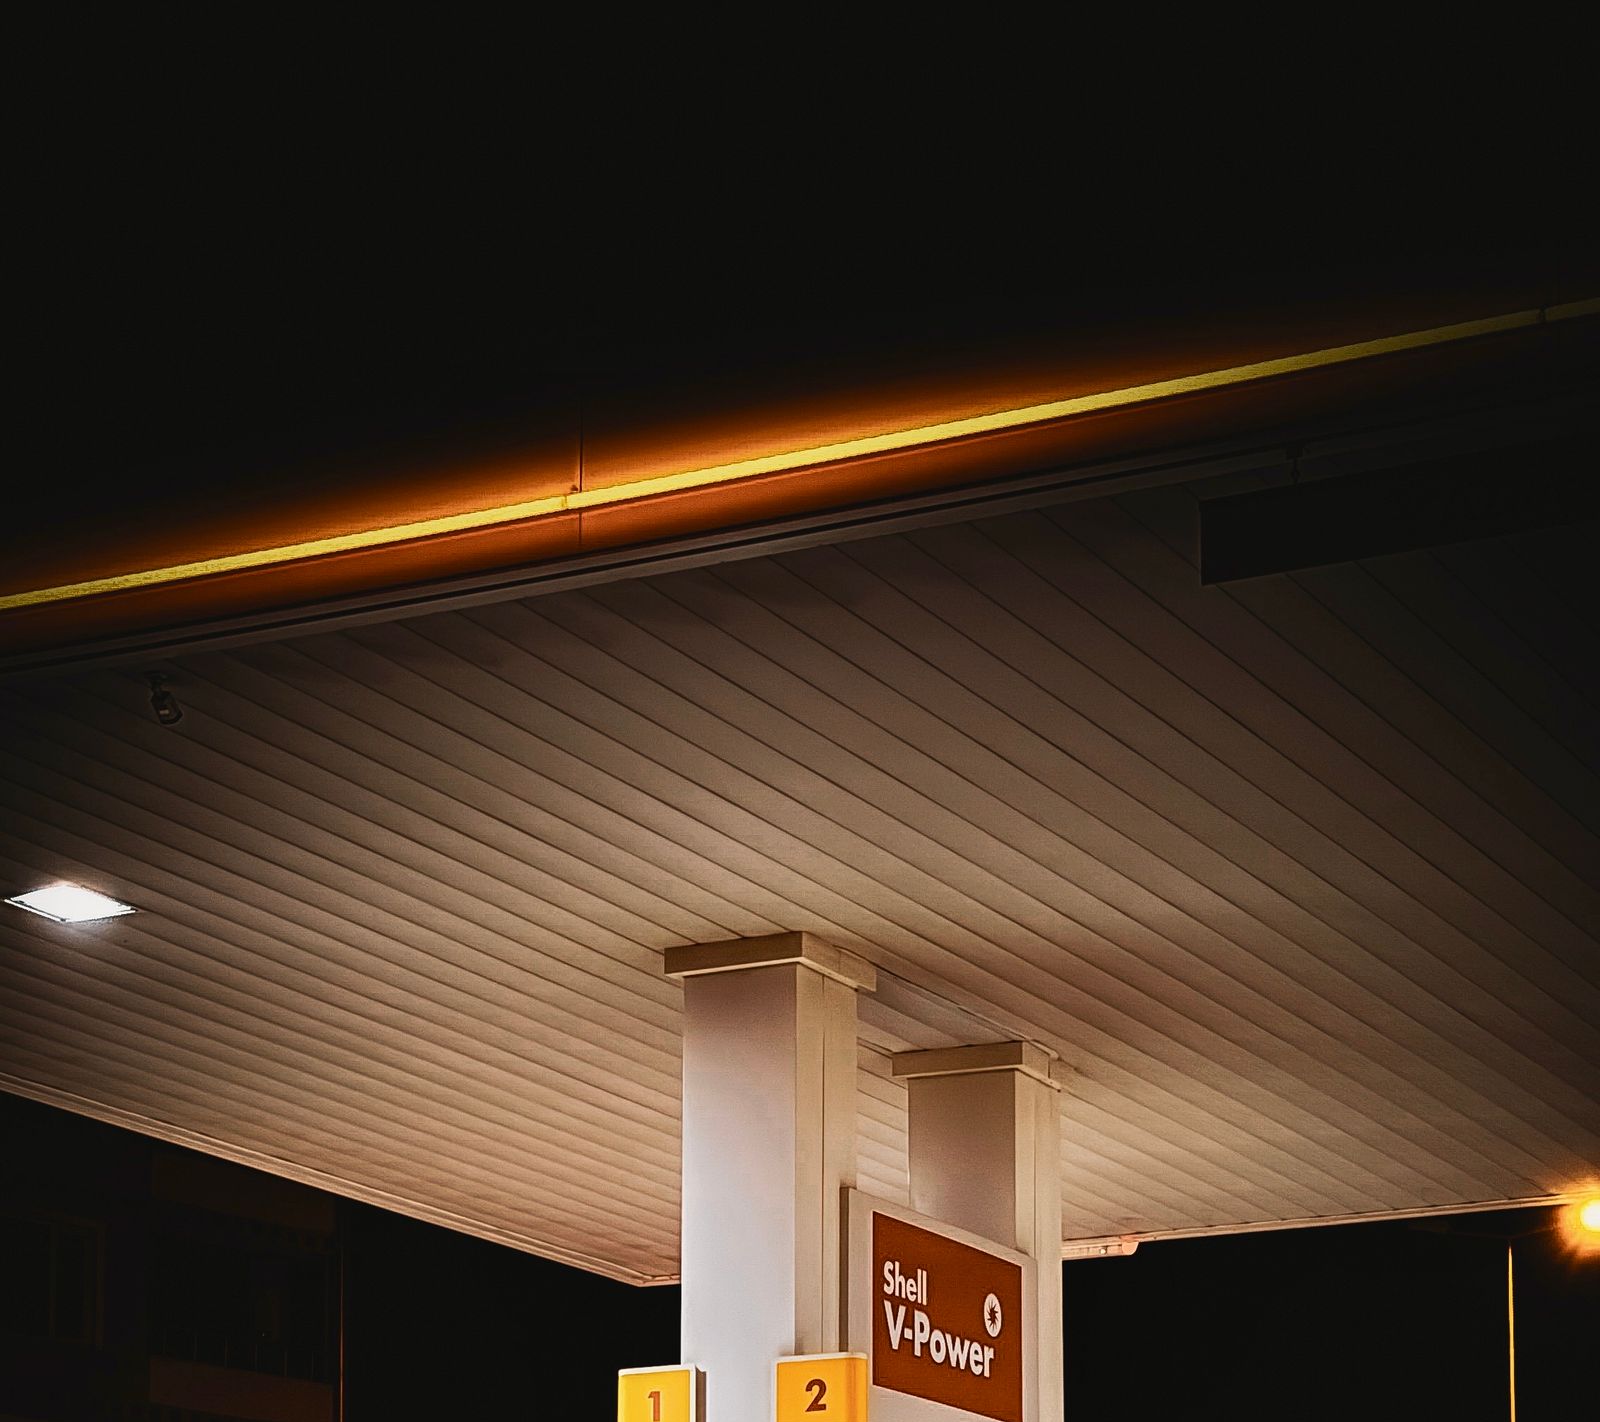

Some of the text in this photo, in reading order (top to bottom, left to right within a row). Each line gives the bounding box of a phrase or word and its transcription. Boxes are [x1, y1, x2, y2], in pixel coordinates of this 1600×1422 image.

[883, 1260, 928, 1306] Shell
[883, 1299, 995, 1378] V-Power
[647, 1390, 661, 1422] 1
[804, 1378, 827, 1413] 2
